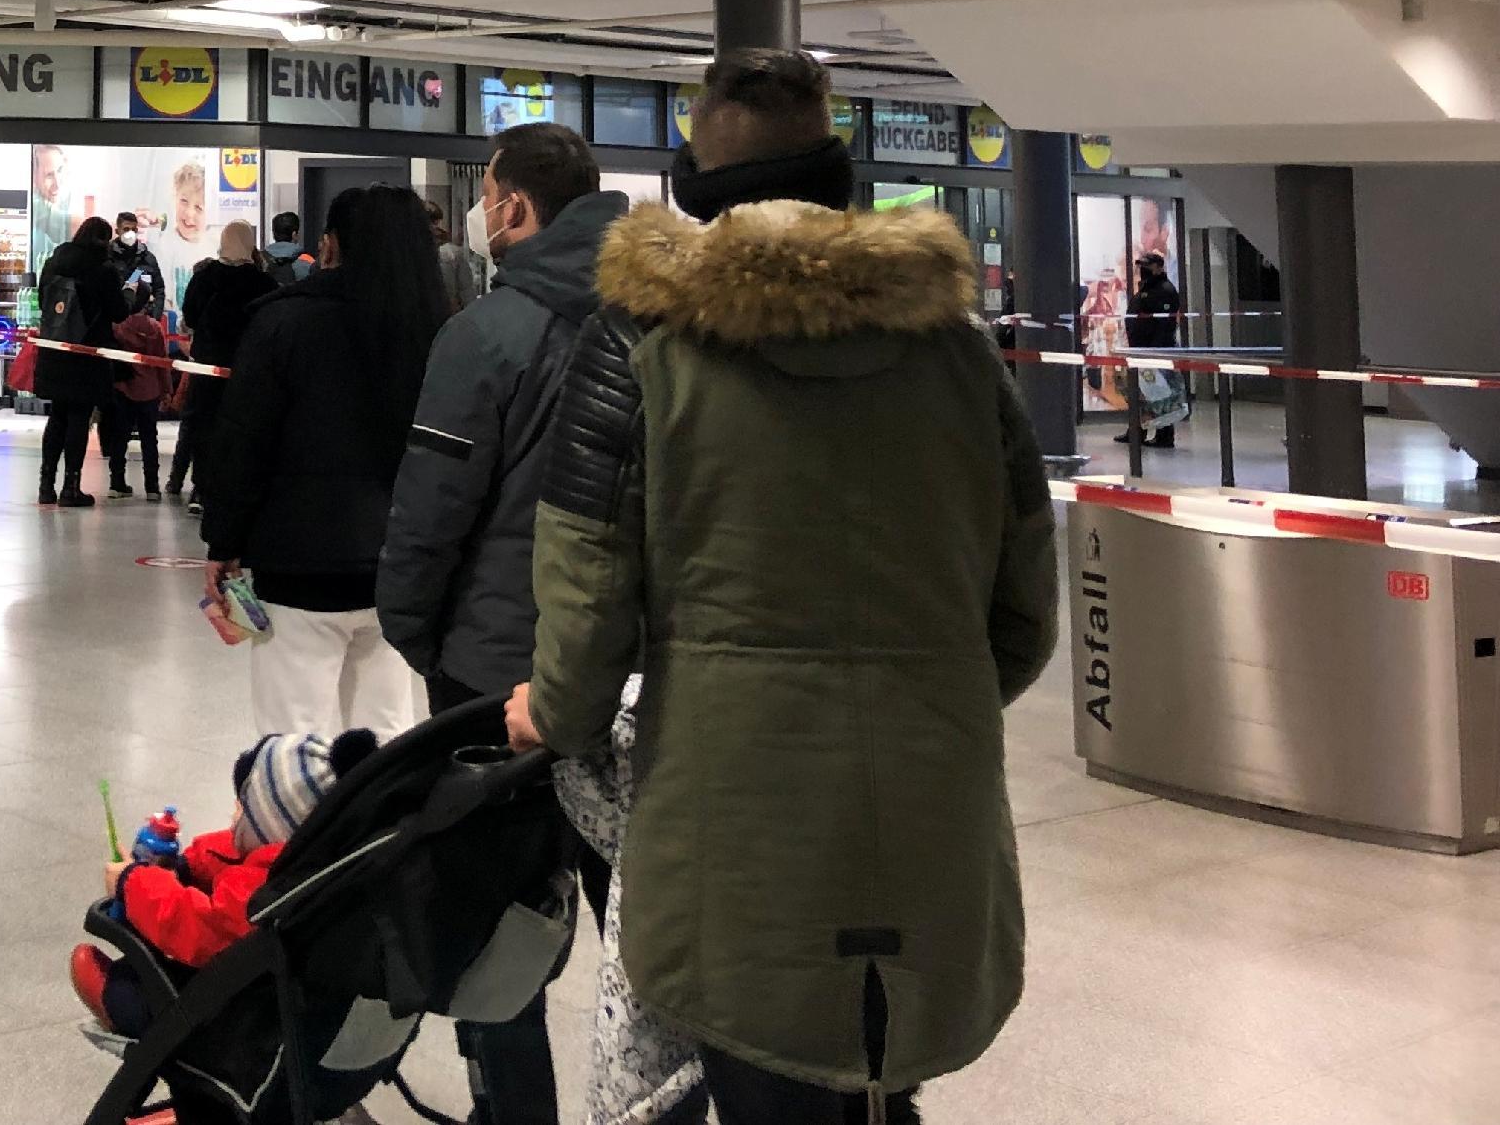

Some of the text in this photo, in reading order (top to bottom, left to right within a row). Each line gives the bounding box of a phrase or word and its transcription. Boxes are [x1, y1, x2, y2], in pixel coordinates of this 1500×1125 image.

[140, 59, 210, 86] LIDL
[271, 57, 440, 108] EINGANG
[1390, 574, 1427, 598] DB
[1082, 570, 1112, 732] Abfall
